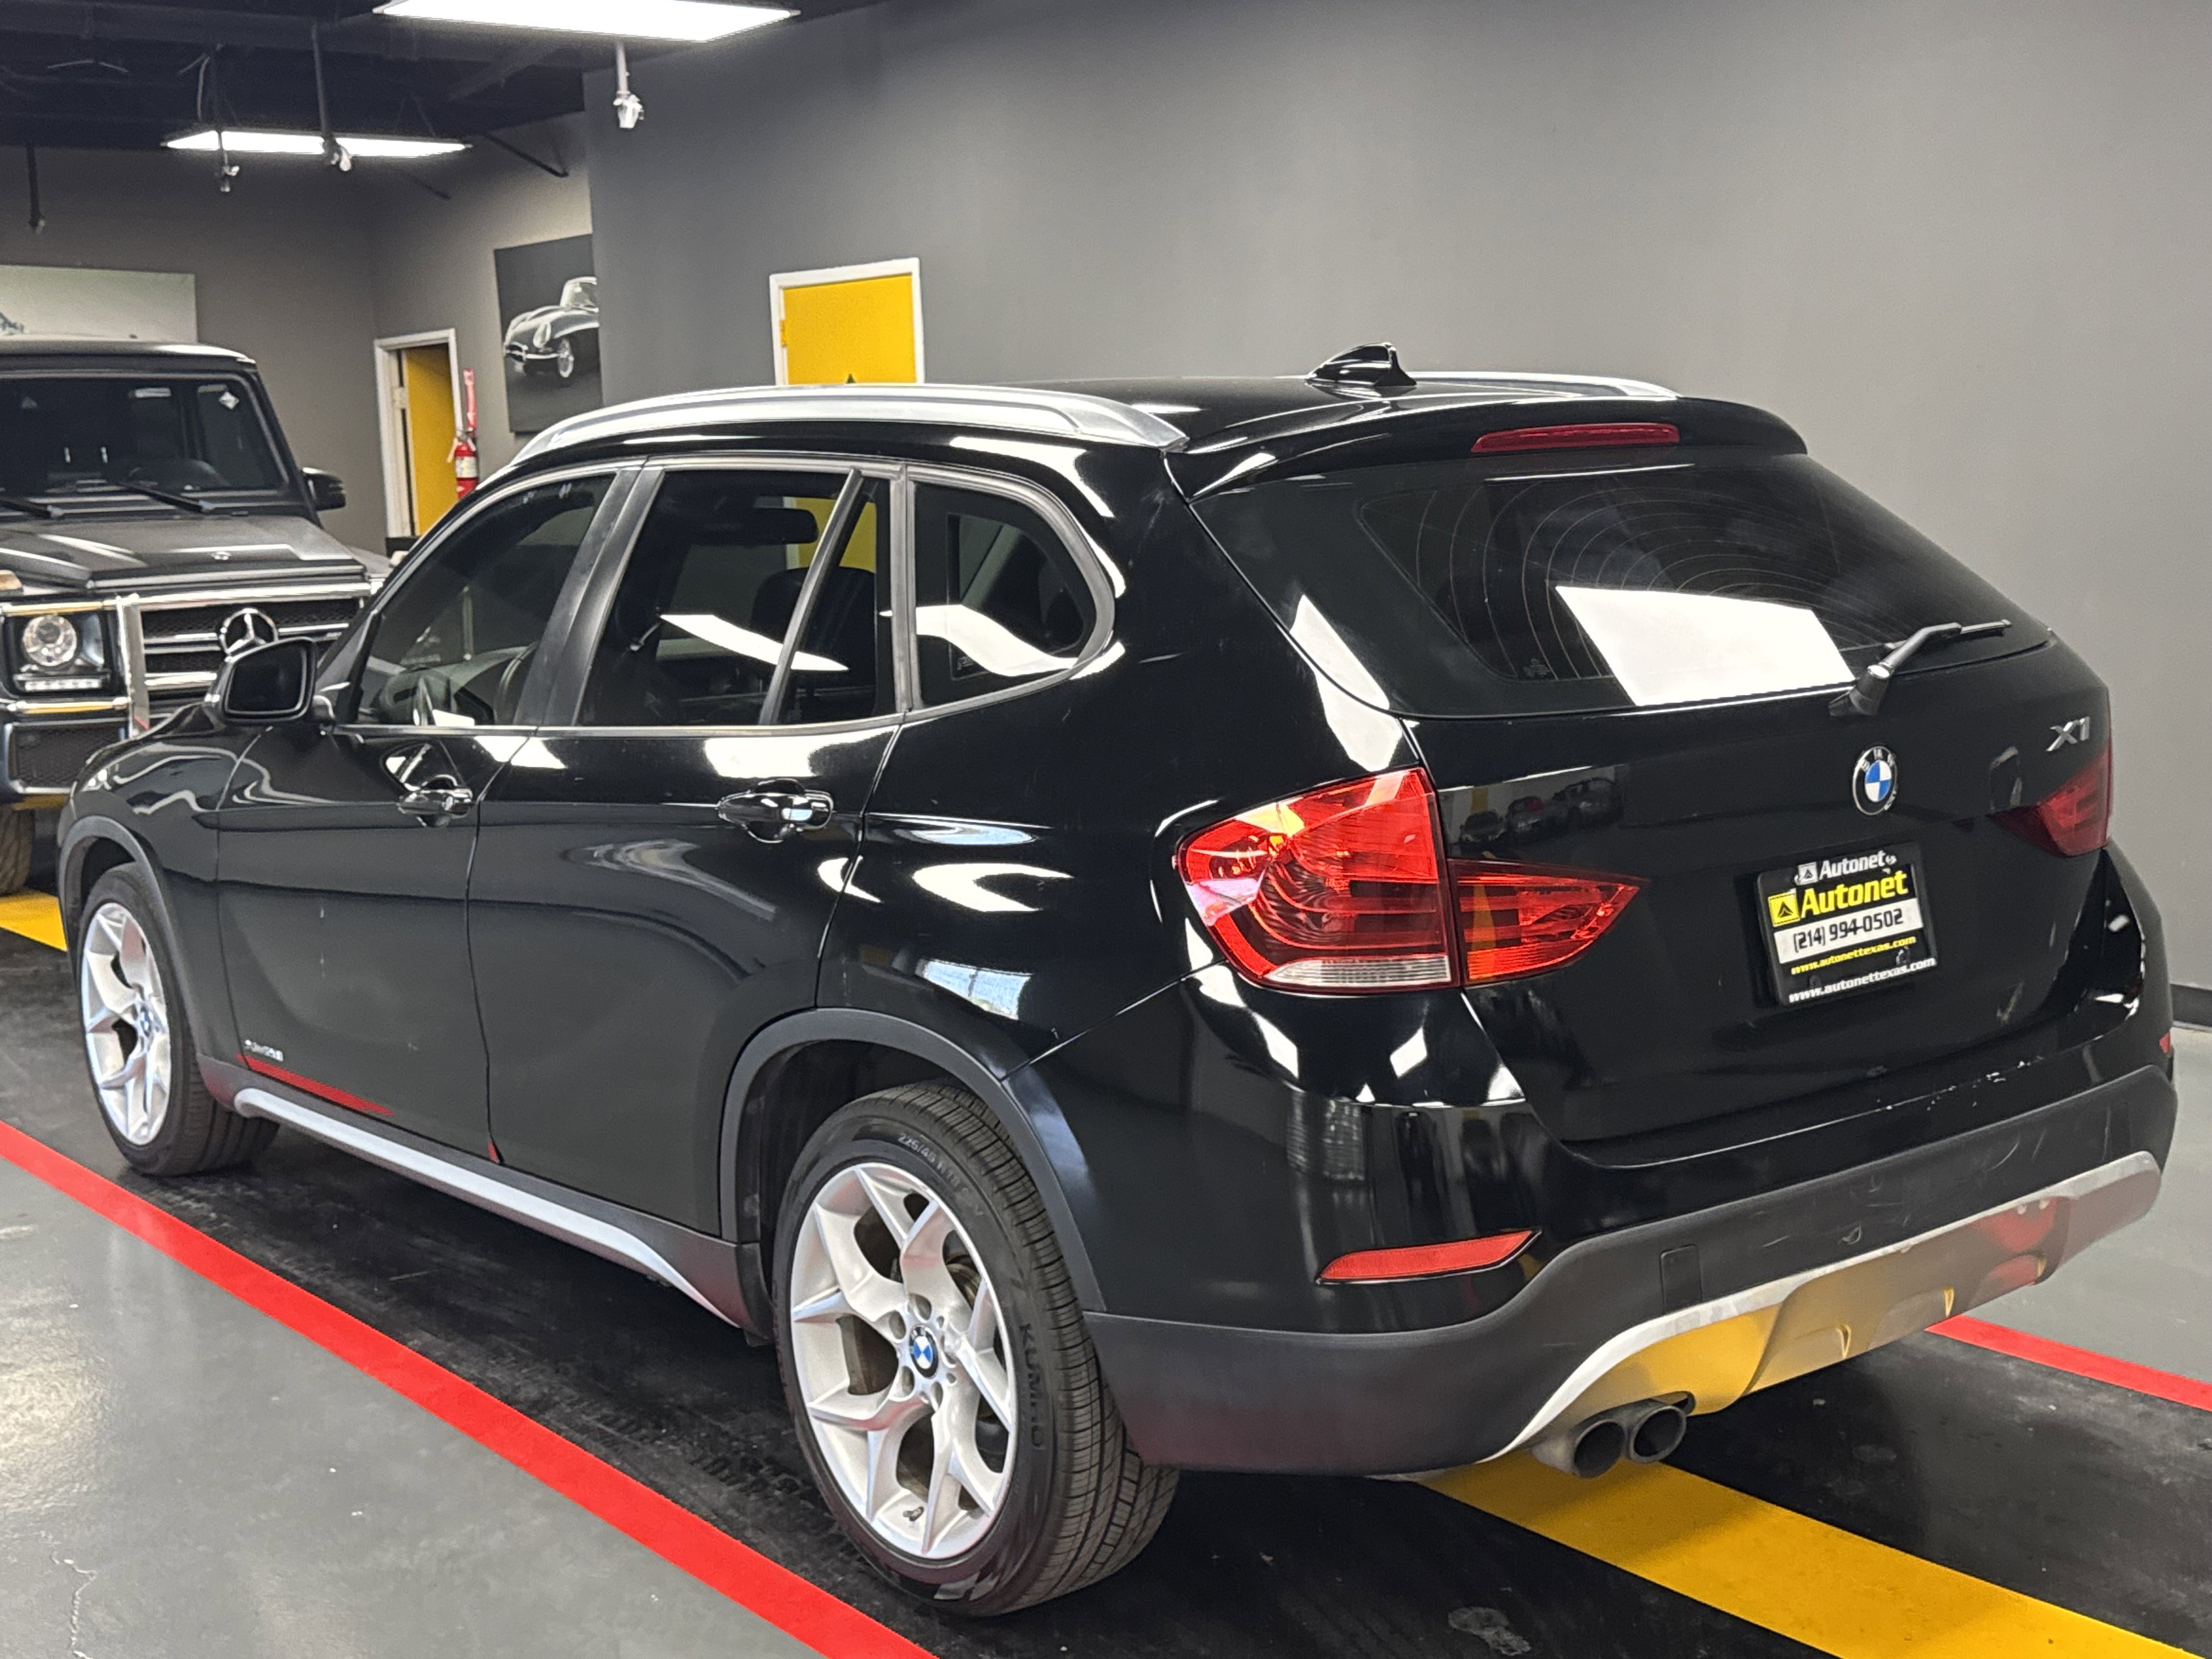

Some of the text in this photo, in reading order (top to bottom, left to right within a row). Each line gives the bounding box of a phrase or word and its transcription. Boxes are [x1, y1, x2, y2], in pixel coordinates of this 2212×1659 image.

[2046, 716, 2090, 752] X1
[1819, 850, 1886, 881] Autonet
[1801, 870, 1909, 919] Autonet
[1793, 908, 1904, 953] (214) 994-0502
[1791, 936, 1917, 975] www.autonettexas.com
[1788, 957, 1937, 1003] www.autonettexas.com
